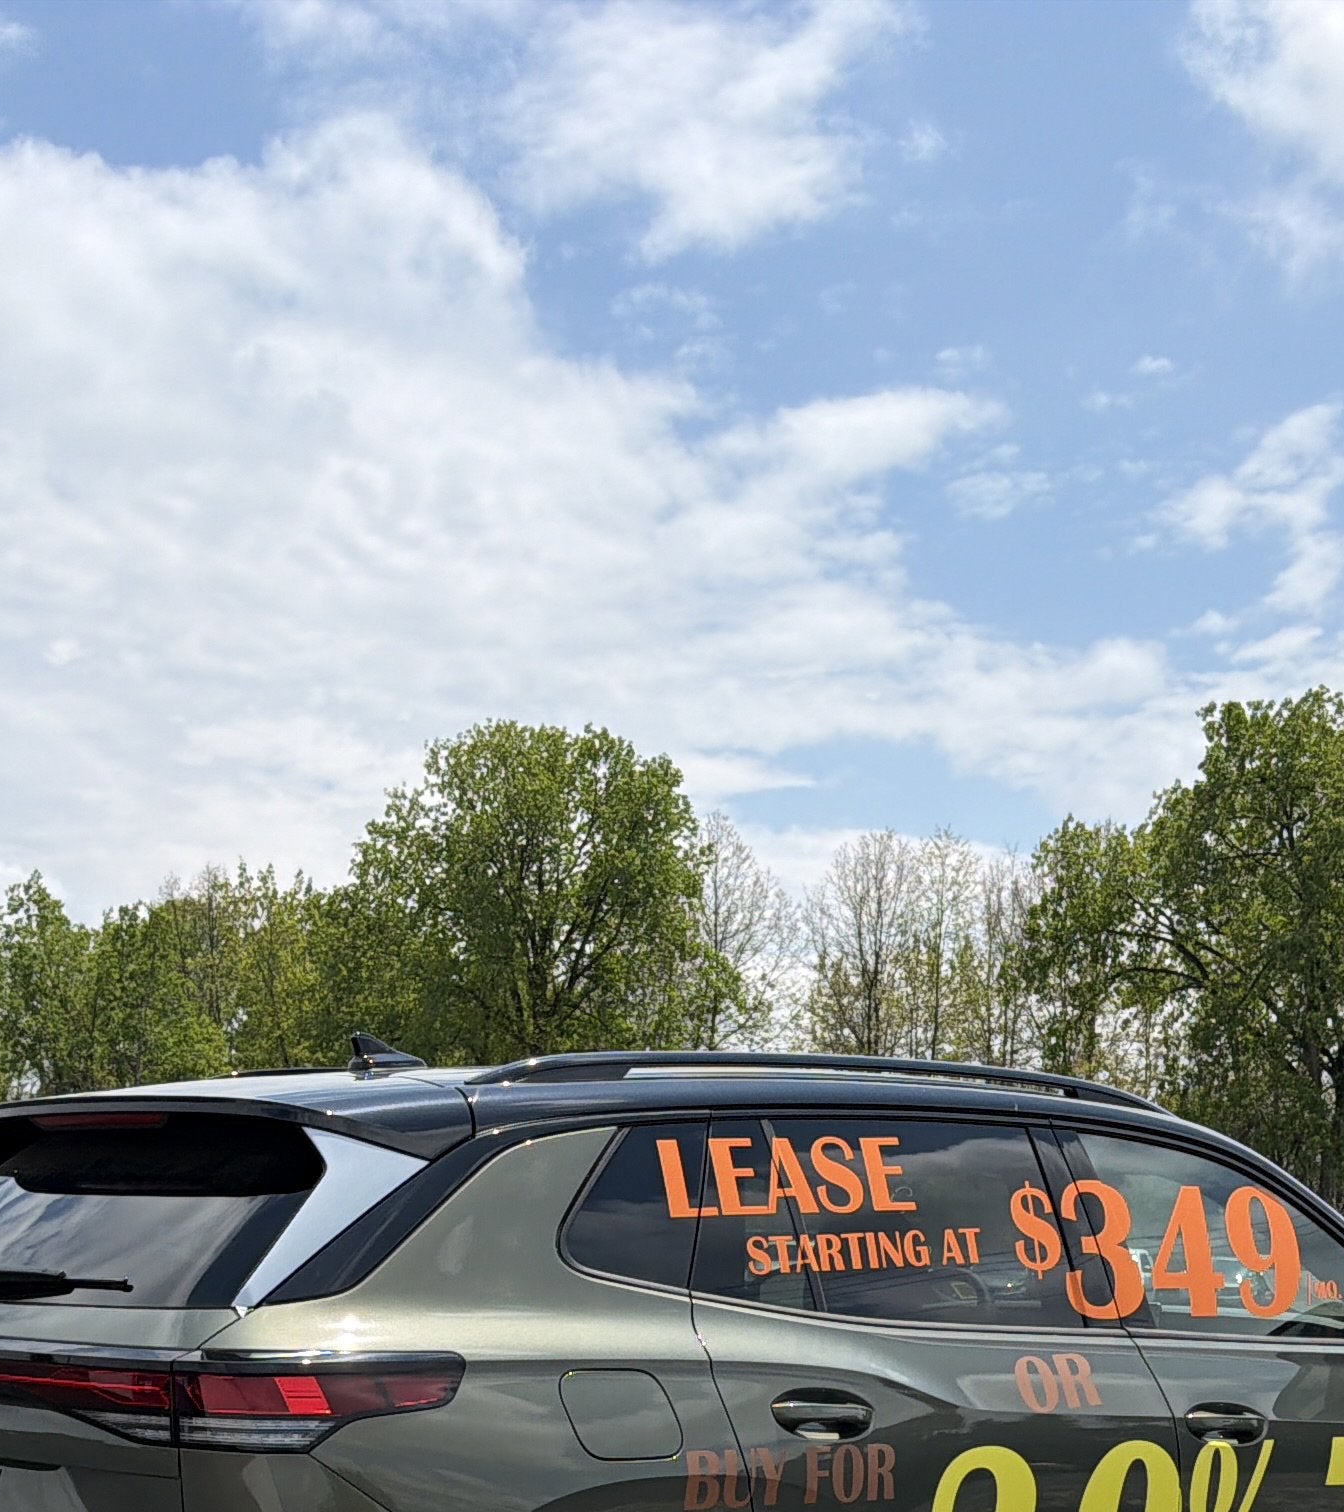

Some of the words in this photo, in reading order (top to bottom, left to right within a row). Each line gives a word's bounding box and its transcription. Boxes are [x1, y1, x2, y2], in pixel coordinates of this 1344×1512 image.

[656, 1136, 918, 1218] LEASE
[746, 1229, 931, 1276] STARTING
[942, 1228, 981, 1266] AT
[1010, 1180, 1302, 1320] $349
[1014, 1353, 1103, 1414] OR
[684, 1446, 786, 1511] BUY
[804, 1442, 896, 1504] FOR
